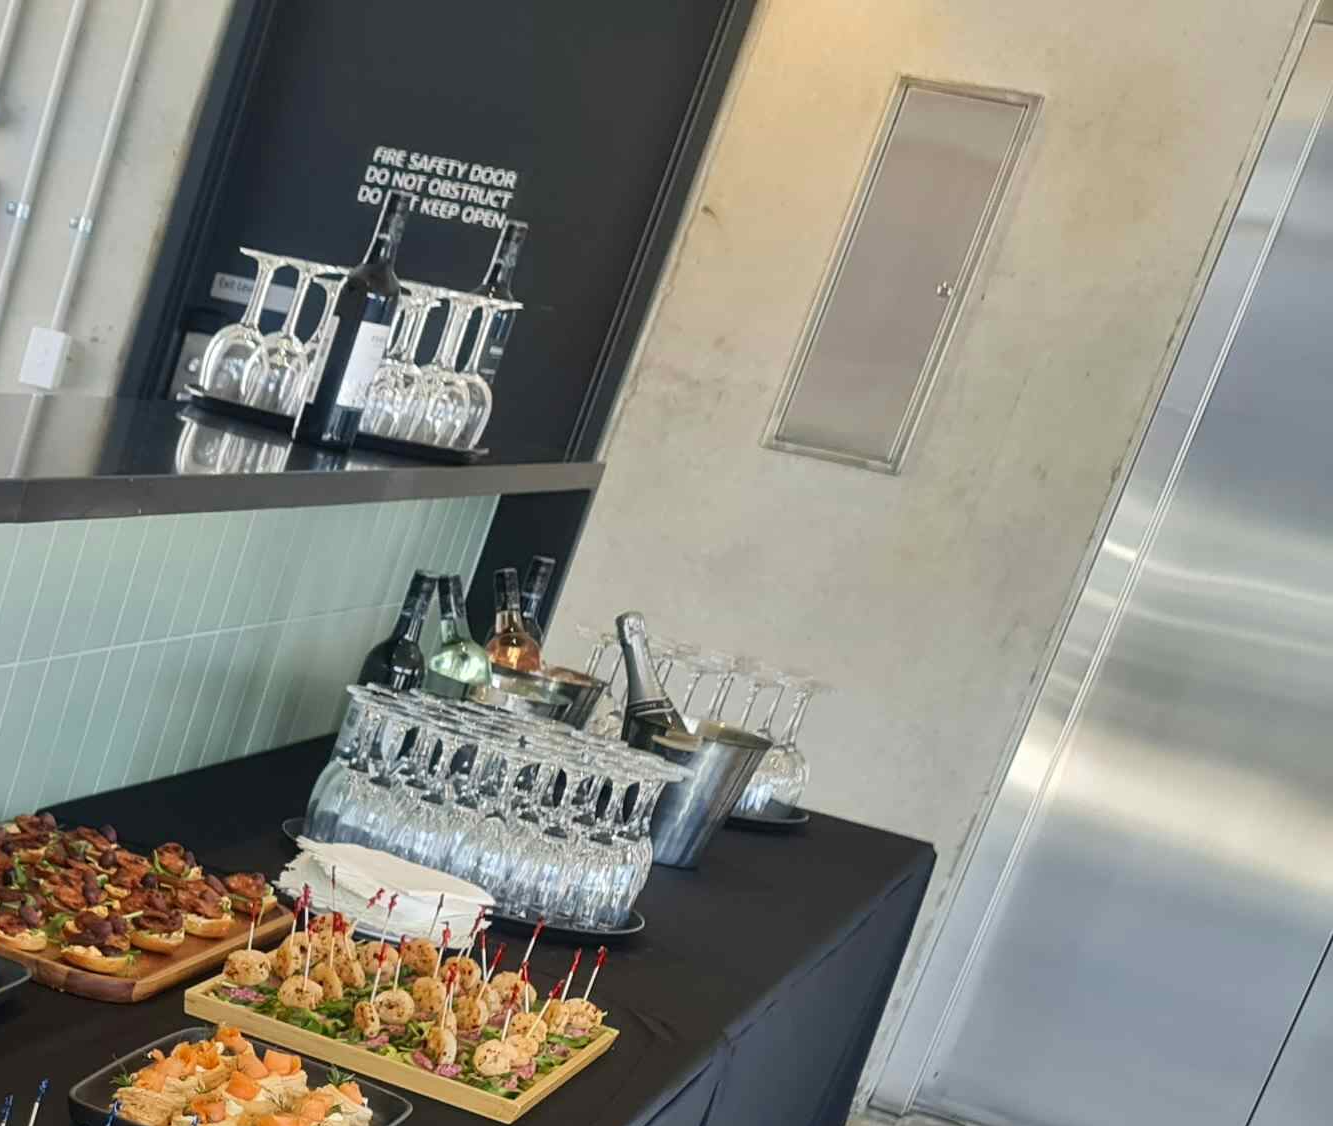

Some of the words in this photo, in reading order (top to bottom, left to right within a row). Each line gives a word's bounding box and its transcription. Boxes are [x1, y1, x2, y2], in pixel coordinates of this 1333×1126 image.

[364, 165, 390, 186] DO
[391, 170, 428, 192] NOT
[427, 178, 514, 209] OBSTRUCT
[372, 146, 407, 168] FIRE
[407, 152, 469, 179] SAFETY
[468, 163, 518, 189] DOOR
[357, 184, 383, 205] DO
[420, 197, 461, 219] KEEP
[461, 206, 507, 229] OPEN
